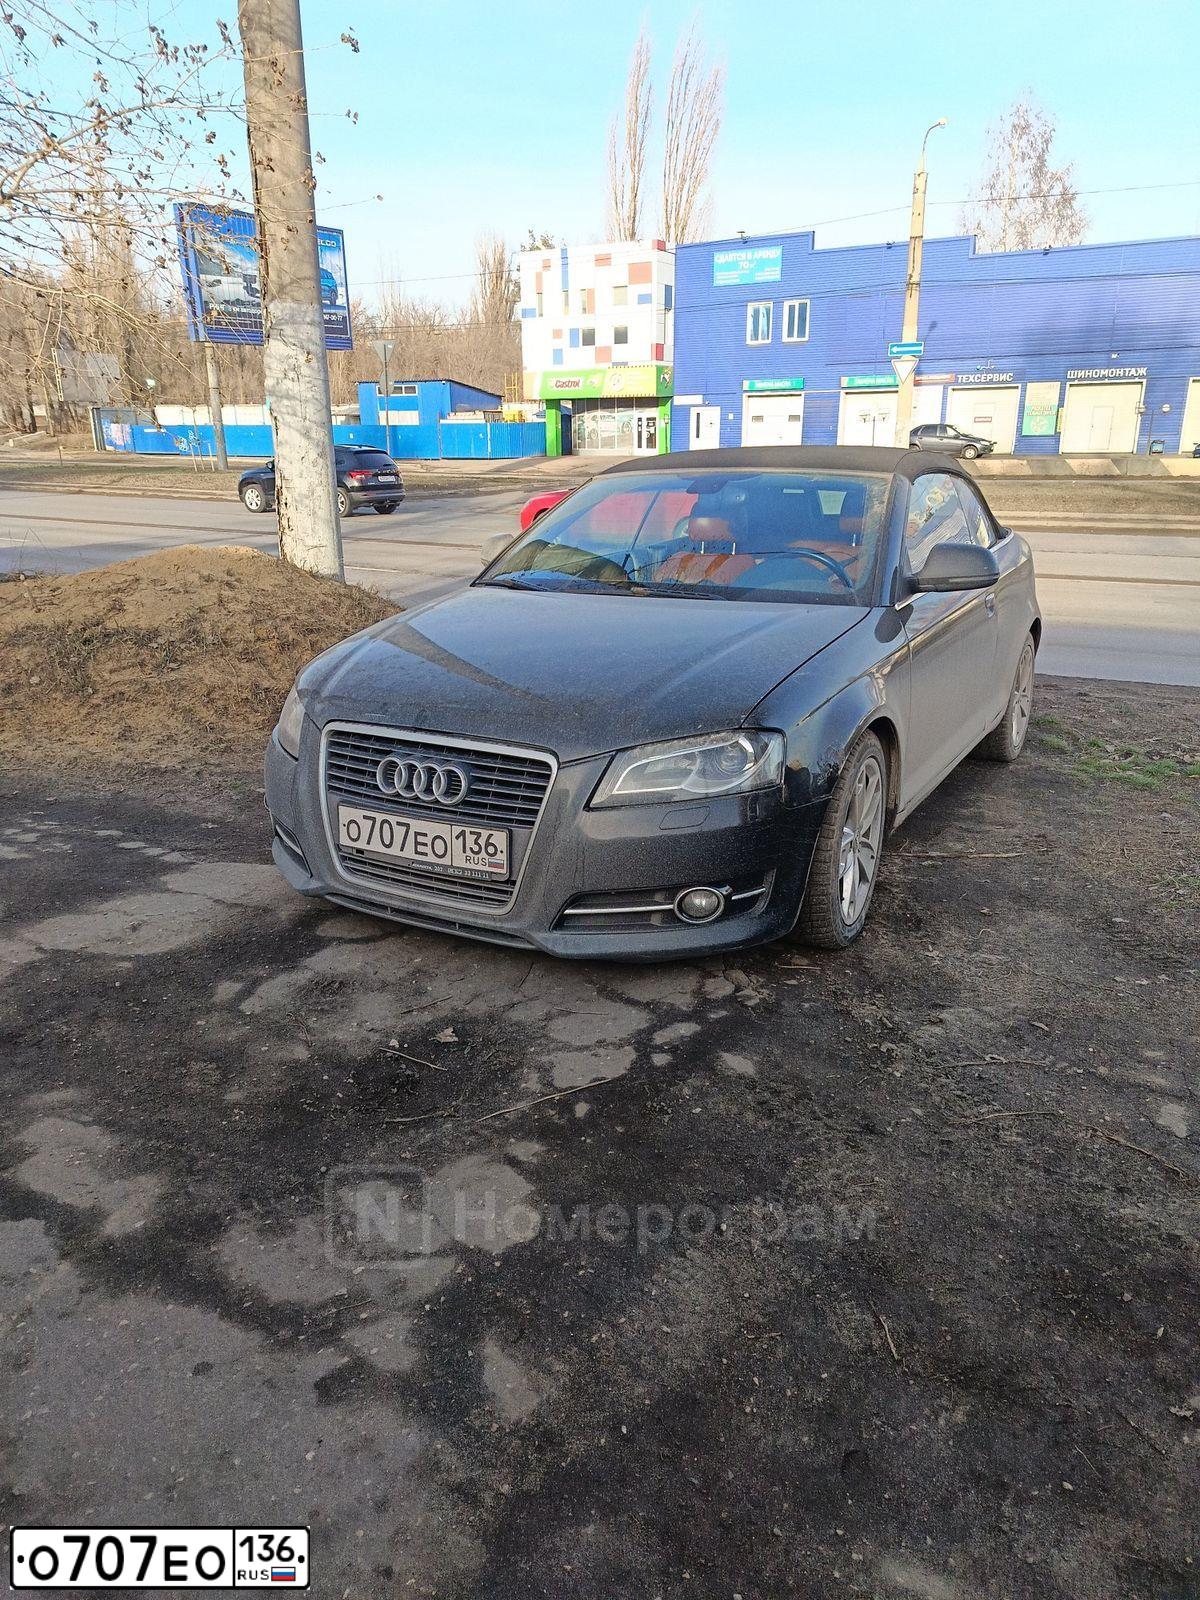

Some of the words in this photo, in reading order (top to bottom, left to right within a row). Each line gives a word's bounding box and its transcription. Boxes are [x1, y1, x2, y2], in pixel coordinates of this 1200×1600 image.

[957, 372, 1014, 384] ТЕХСЕРВИС
[1067, 367, 1148, 379] ШИНОМОНТАЖ
[554, 378, 581, 389] Castrol
[346, 814, 448, 859] О707ЕО
[455, 829, 499, 858] 136
[465, 855, 488, 867] RUS
